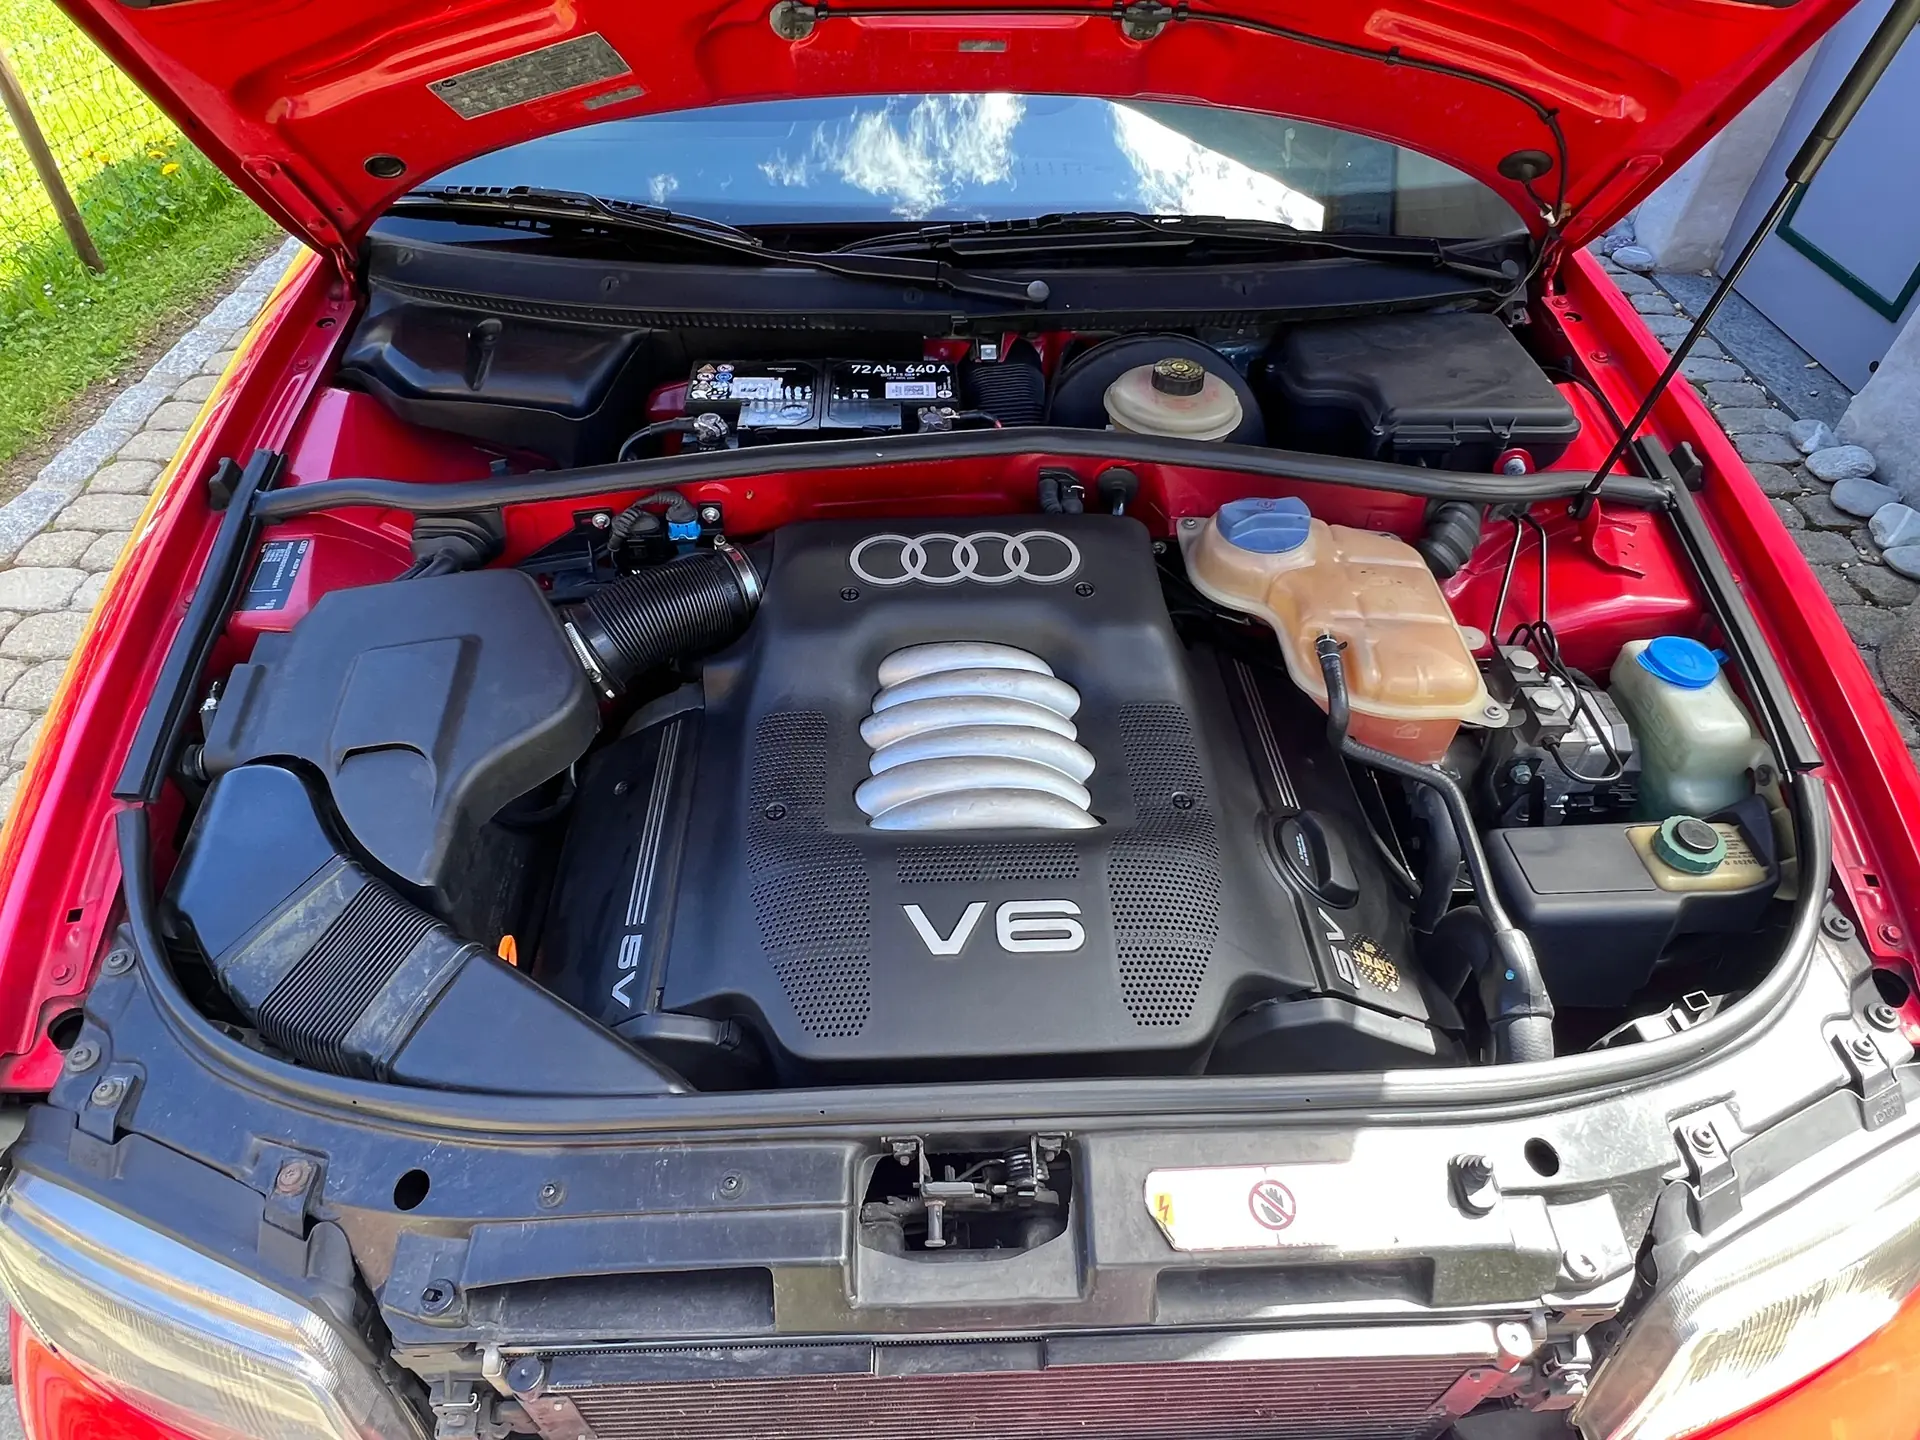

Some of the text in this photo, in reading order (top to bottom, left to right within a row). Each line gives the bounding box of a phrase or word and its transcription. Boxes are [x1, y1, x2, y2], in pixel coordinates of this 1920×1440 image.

[852, 364, 950, 374] 72Ah 640A
[902, 899, 1086, 956] V6
[1317, 906, 1361, 989] 5V
[612, 934, 643, 1010] 5V
